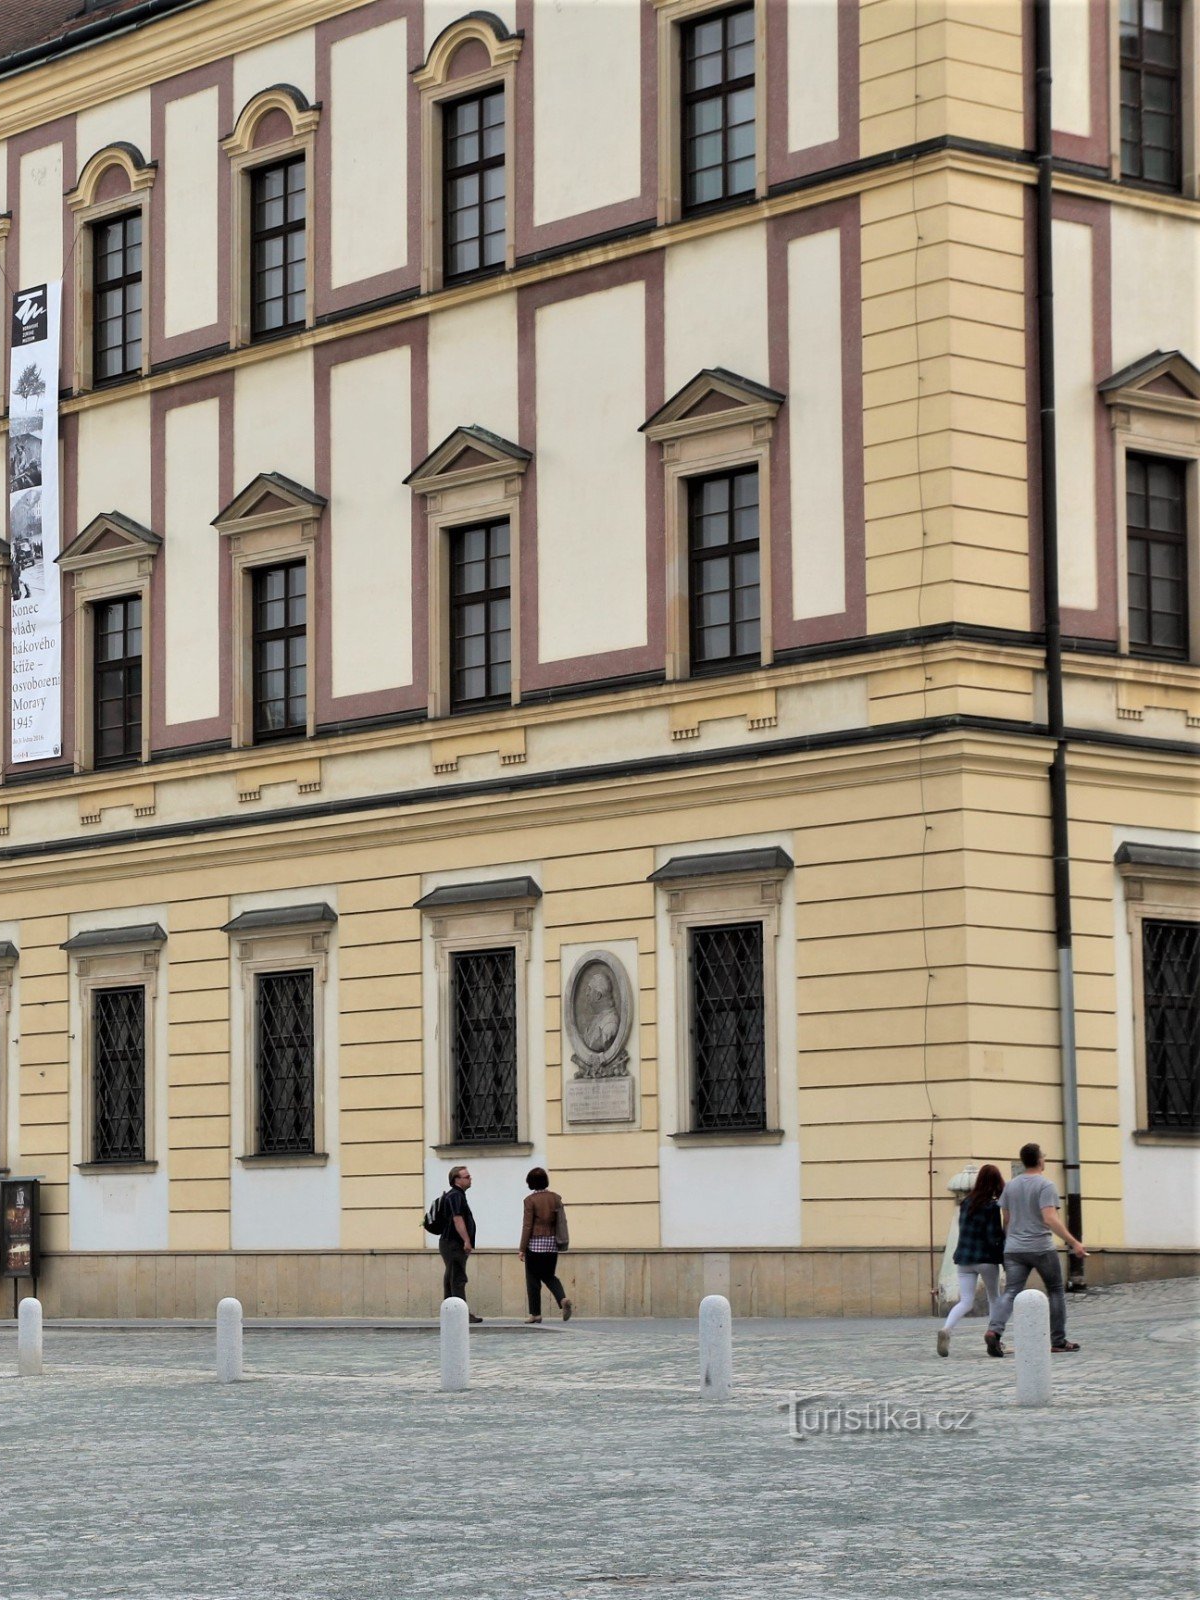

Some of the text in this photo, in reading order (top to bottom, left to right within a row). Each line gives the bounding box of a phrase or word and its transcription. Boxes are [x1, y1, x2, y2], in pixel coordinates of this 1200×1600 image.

[12, 603, 39, 618] Konec
[12, 620, 37, 636] vlády
[12, 636, 56, 655] hákového
[12, 659, 35, 674] kříže
[12, 696, 47, 712] Moravy
[12, 715, 33, 731] 1945
